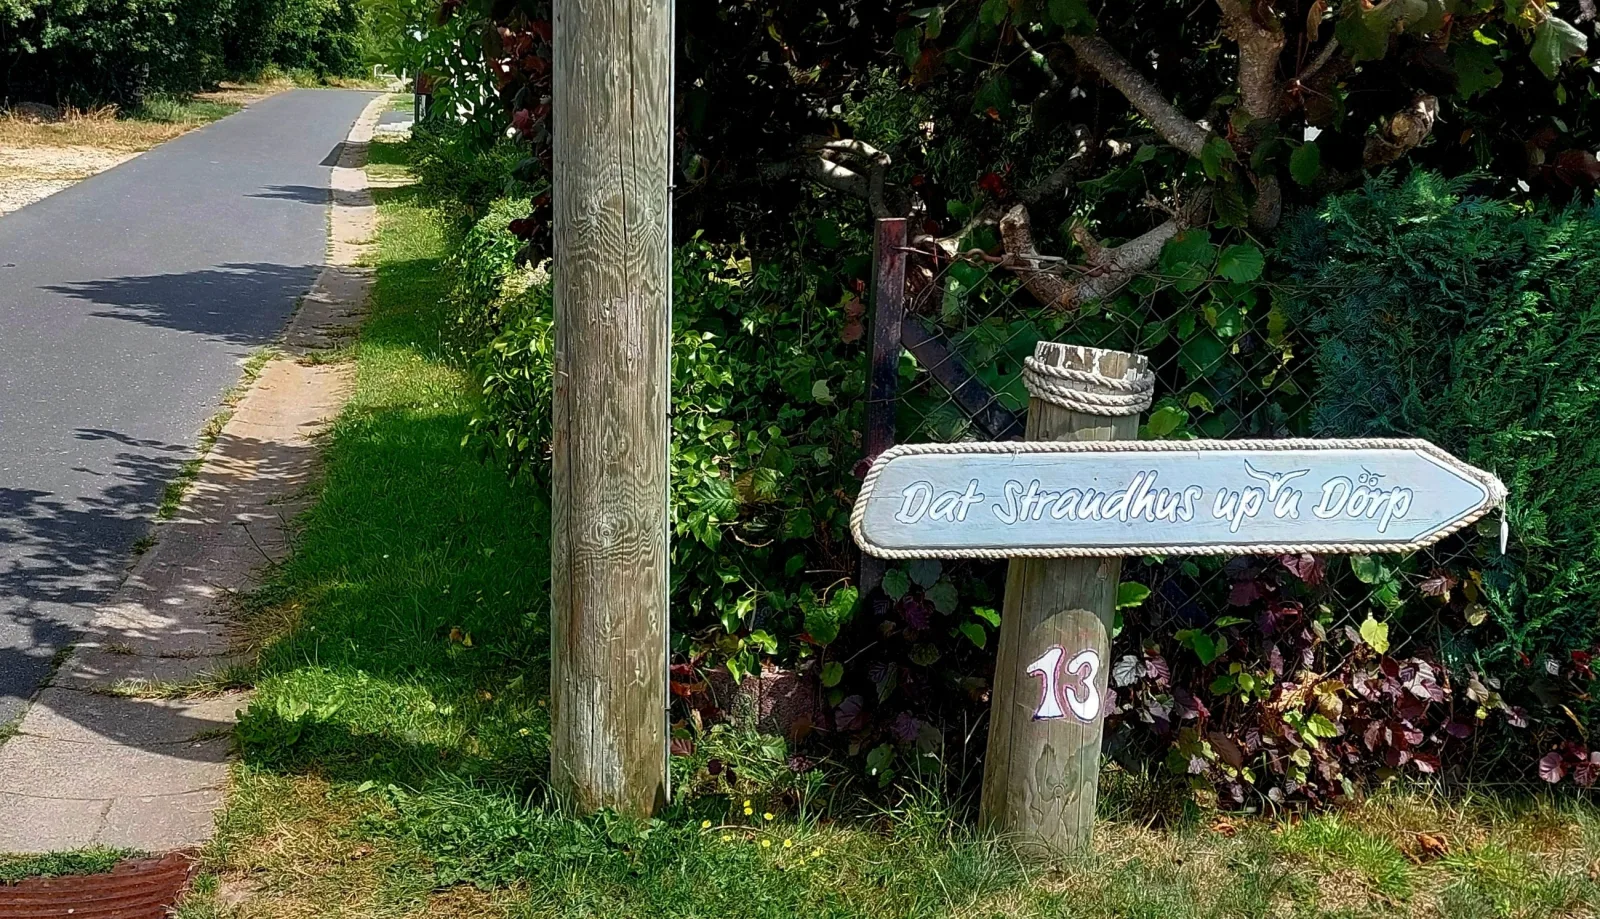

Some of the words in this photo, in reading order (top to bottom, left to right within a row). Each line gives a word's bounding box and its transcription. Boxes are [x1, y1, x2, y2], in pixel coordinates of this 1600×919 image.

[896, 478, 986, 524] Dat
[1312, 470, 1414, 534] Dörp
[1026, 645, 1100, 722] 13
